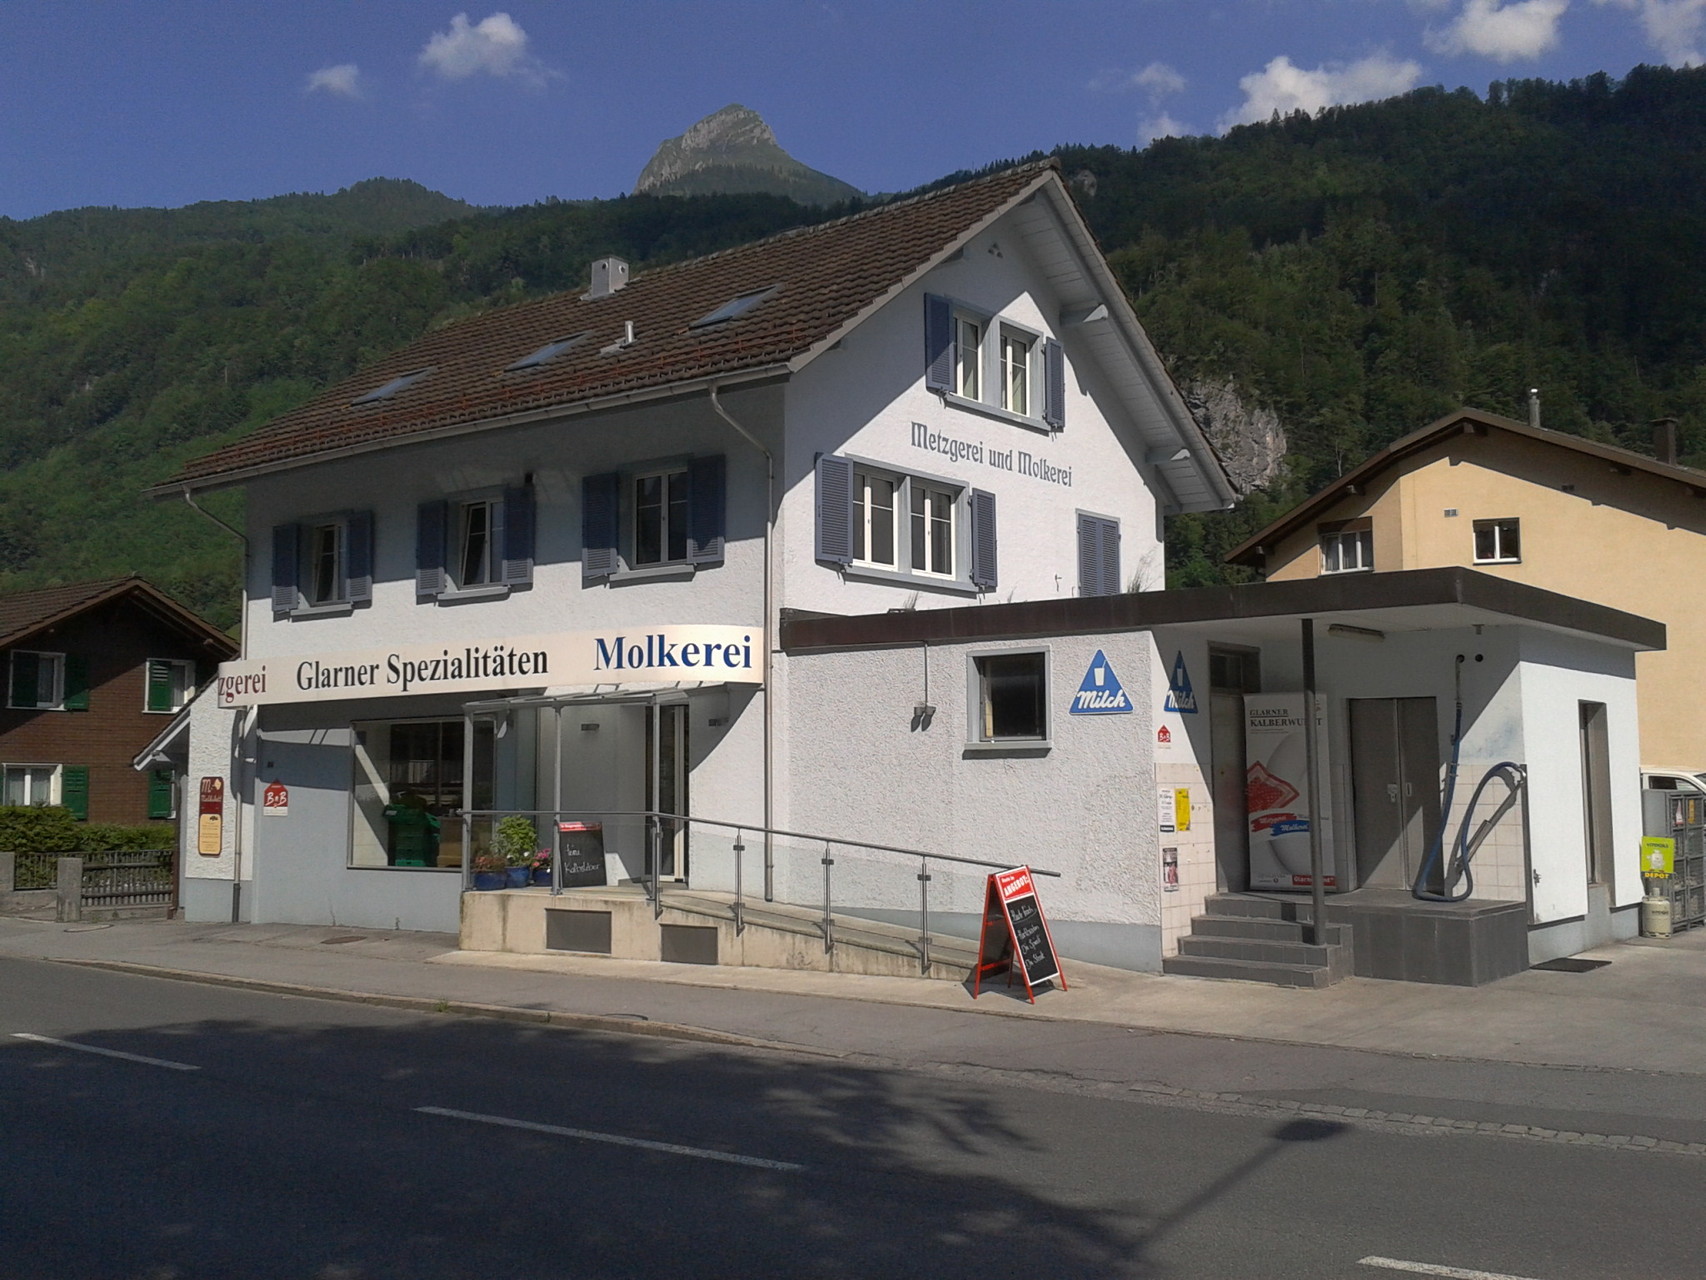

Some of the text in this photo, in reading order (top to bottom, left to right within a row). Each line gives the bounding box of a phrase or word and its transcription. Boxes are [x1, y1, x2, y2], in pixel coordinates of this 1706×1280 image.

[911, 421, 1073, 487] Metzgerei und Molkerei
[594, 634, 752, 672] Molkerei
[297, 646, 548, 692] Glarner Spezialitäten
[1078, 689, 1126, 709] Milch
[1167, 689, 1195, 709] Milch
[1250, 718, 1322, 727] KALBERWUT
